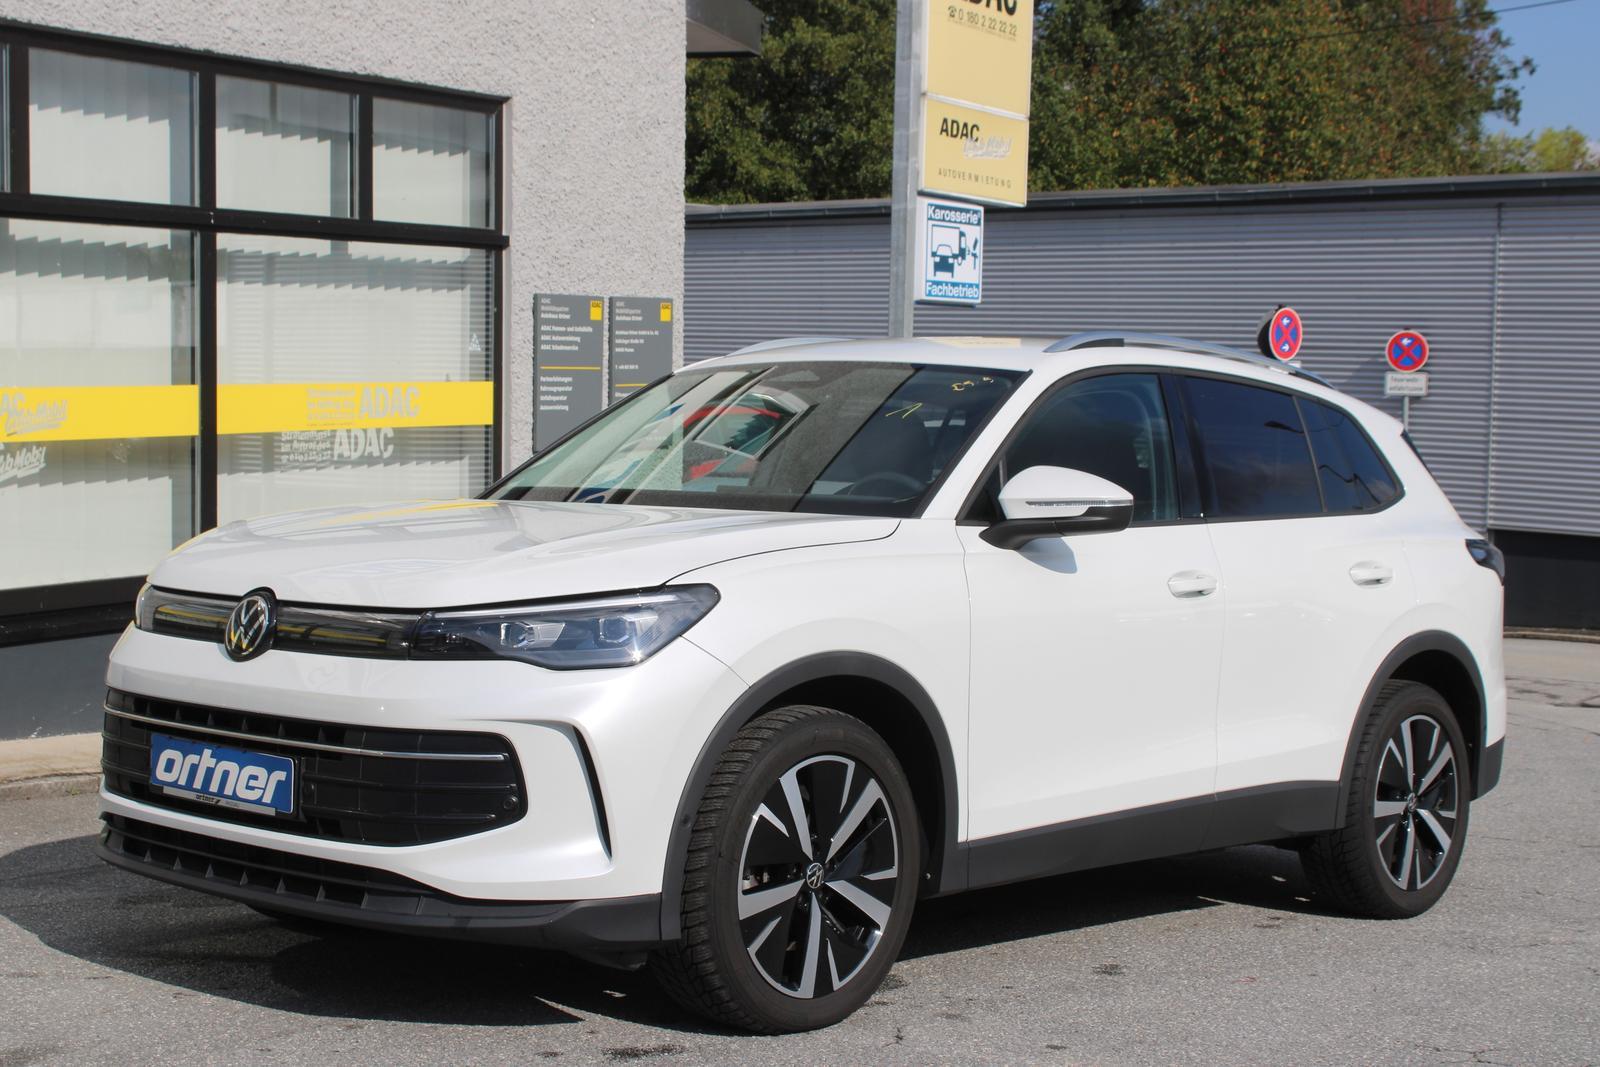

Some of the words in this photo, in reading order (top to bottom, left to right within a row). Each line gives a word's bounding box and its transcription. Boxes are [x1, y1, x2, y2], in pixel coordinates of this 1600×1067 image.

[940, 116, 980, 143] ADAC
[938, 167, 1012, 189] AUTOVERMIETUNG
[926, 281, 979, 298] Fachbetrieb
[360, 386, 421, 419] ADAC
[333, 427, 395, 461] ADAC
[155, 748, 287, 804] ortner
